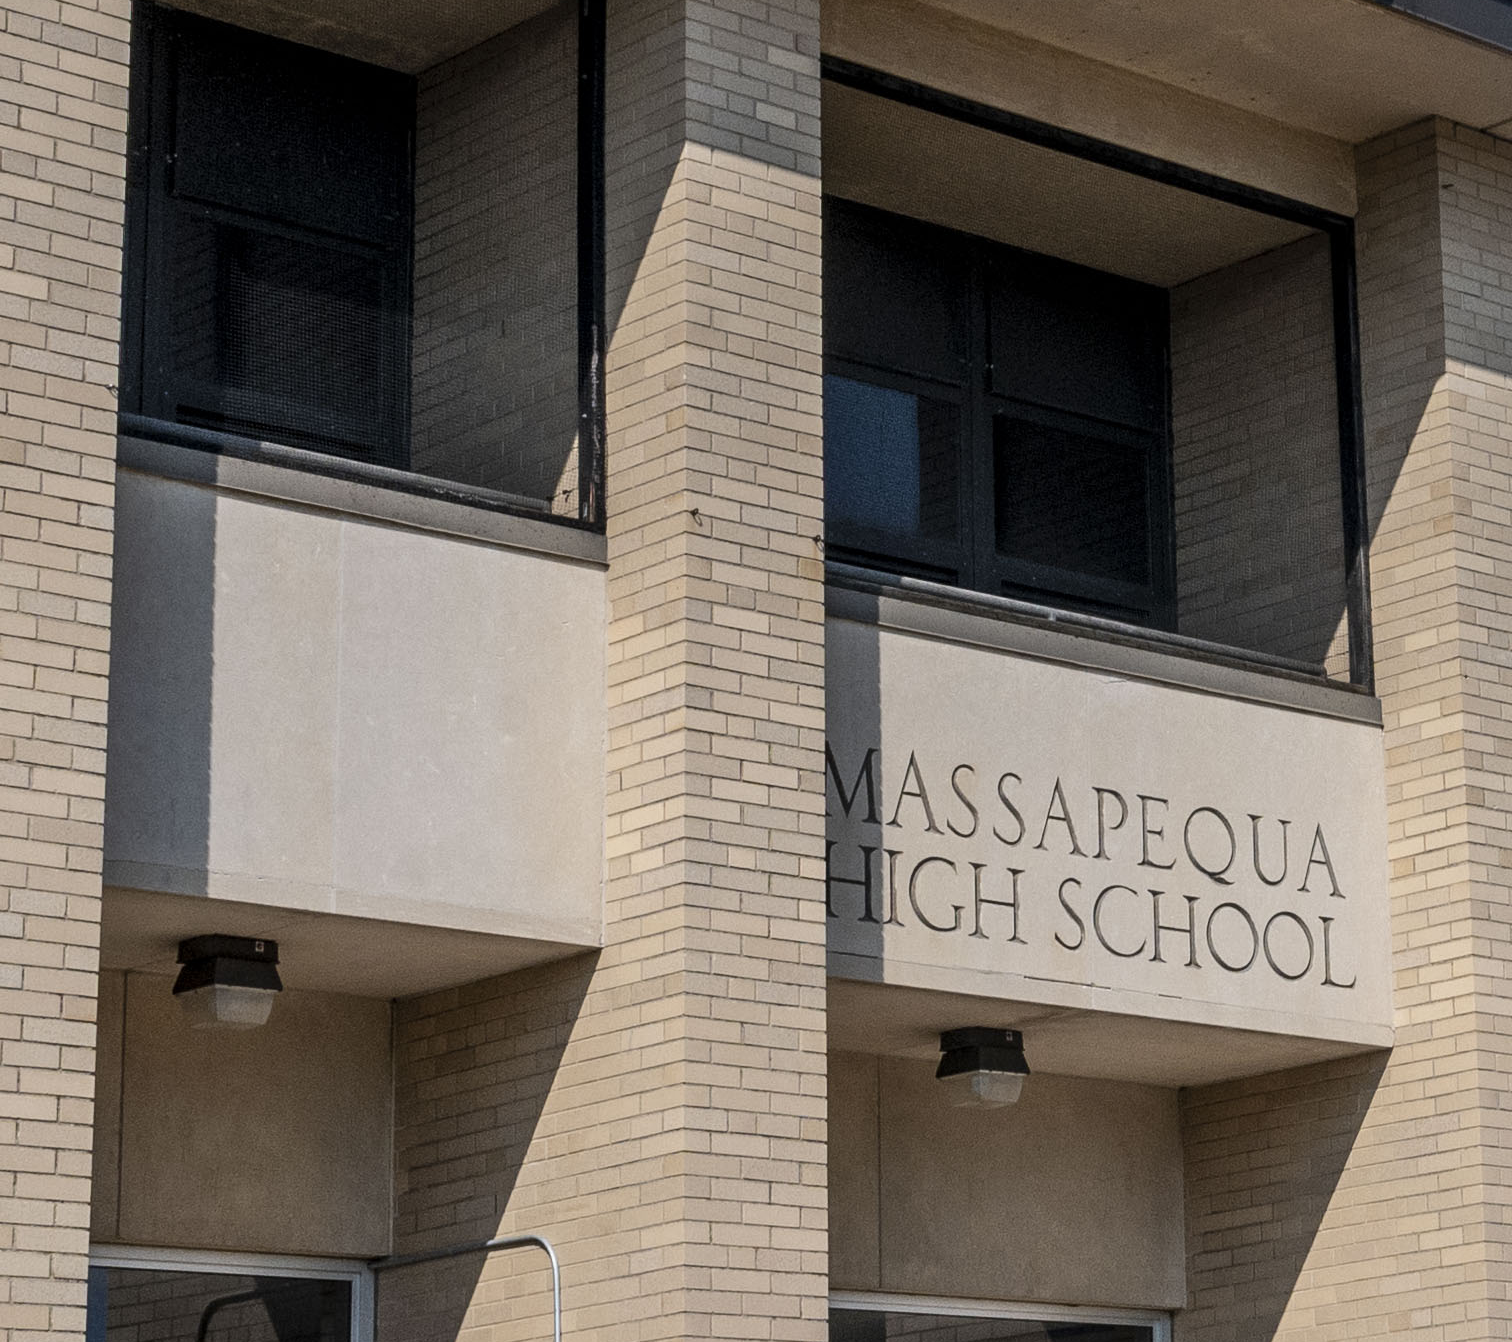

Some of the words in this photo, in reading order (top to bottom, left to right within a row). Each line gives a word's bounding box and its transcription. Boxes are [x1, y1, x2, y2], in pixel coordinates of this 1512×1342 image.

[824, 740, 1346, 899] MASSAPEQUA
[825, 838, 1028, 944] HIGH
[1054, 876, 1357, 990] SCHOOL
